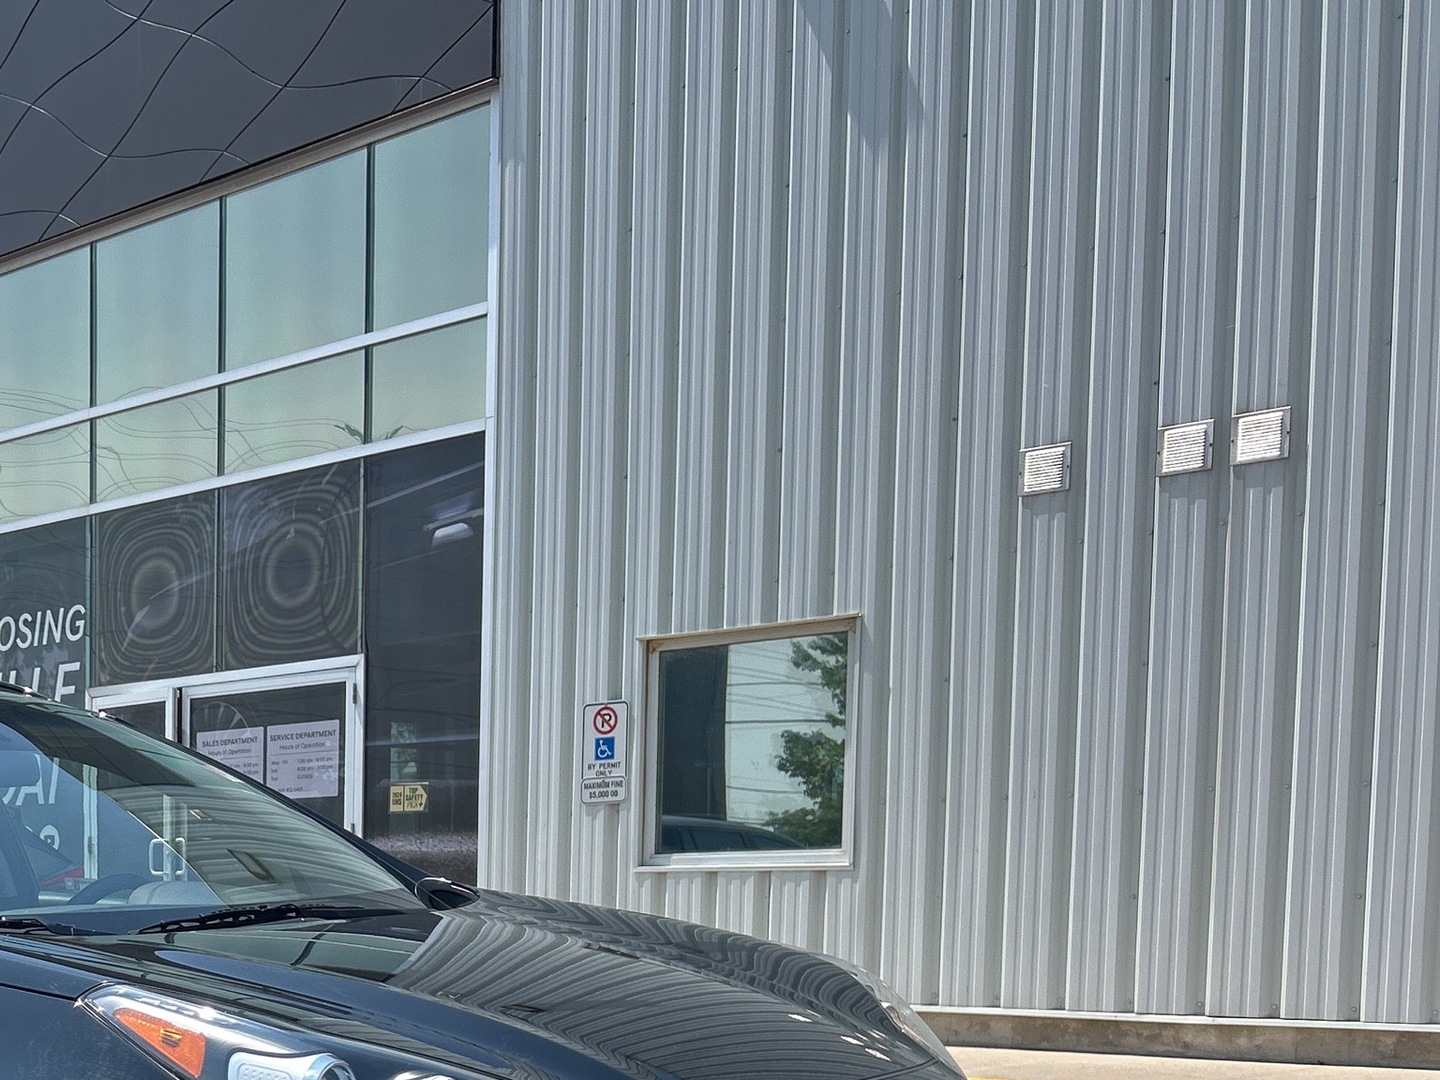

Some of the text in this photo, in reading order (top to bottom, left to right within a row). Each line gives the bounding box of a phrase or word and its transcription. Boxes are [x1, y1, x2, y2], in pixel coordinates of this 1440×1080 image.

[269, 729, 336, 742] SERVICE DEPARTMENT
[201, 736, 258, 748] SALES DEPARTMENT
[598, 761, 621, 770] PERMIT
[583, 780, 624, 790] MAXIMUM FINE
